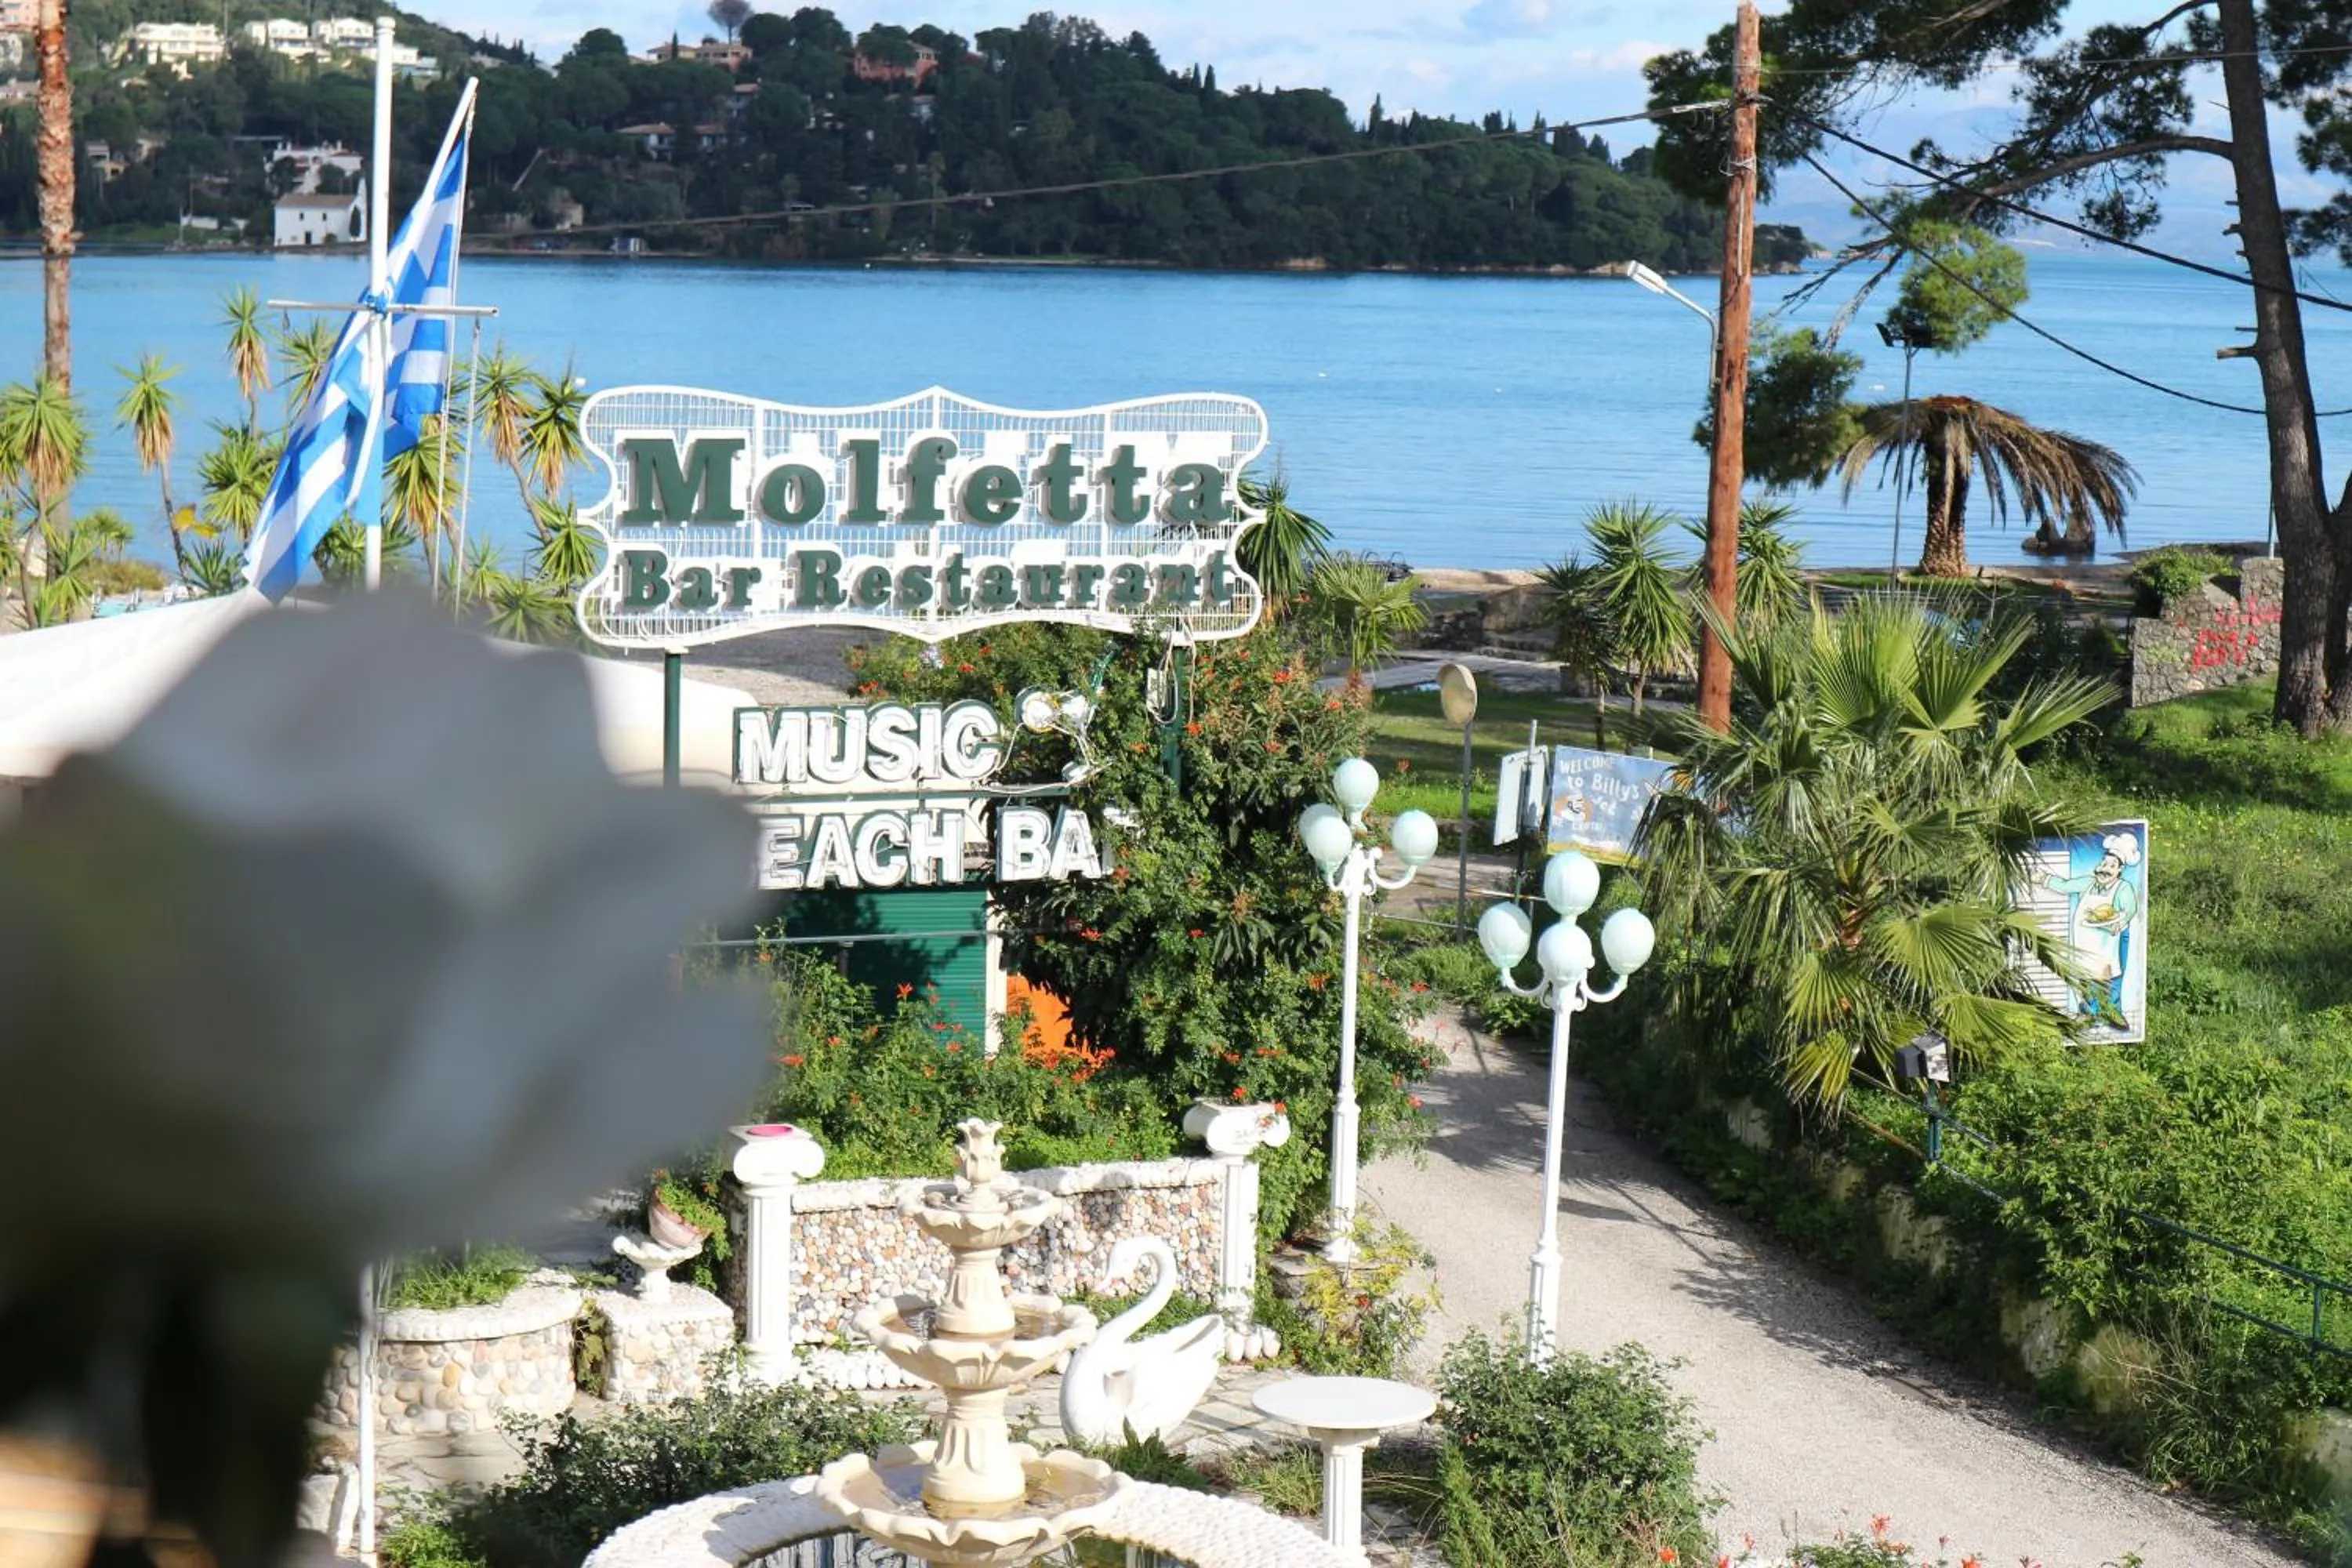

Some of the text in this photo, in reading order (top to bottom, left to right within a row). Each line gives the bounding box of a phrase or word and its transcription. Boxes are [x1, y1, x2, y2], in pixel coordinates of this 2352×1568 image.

[619, 435, 1229, 525] Molfetta
[622, 547, 1236, 609] Bar Restaurant
[734, 699, 1000, 784] MUSIC
[1567, 775, 1584, 789] to
[758, 810, 967, 890] EACH
